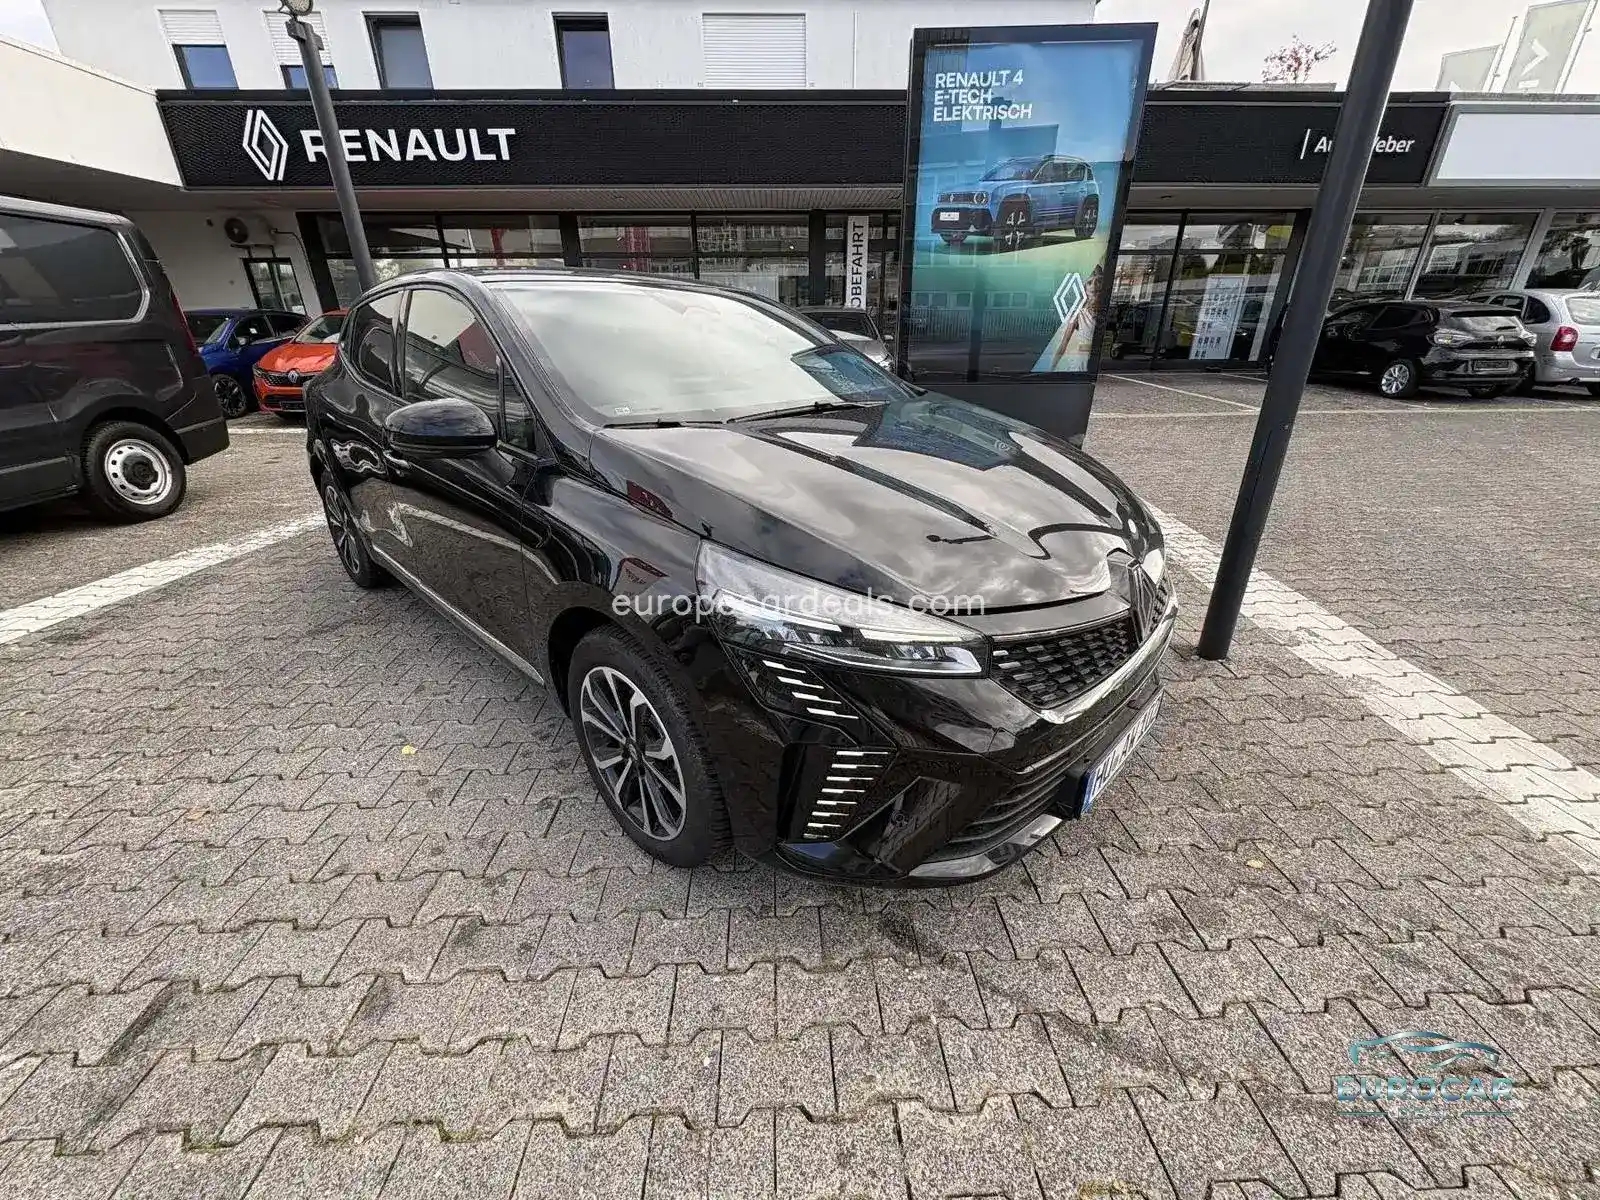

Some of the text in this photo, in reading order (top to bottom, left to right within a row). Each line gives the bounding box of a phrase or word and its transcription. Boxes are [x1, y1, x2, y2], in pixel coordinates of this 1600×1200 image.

[935, 69, 1024, 89] RENAULT 4
[934, 88, 992, 105] E-TECH
[933, 103, 1033, 122] ELEKTRISCH
[300, 128, 516, 162] RENAULT
